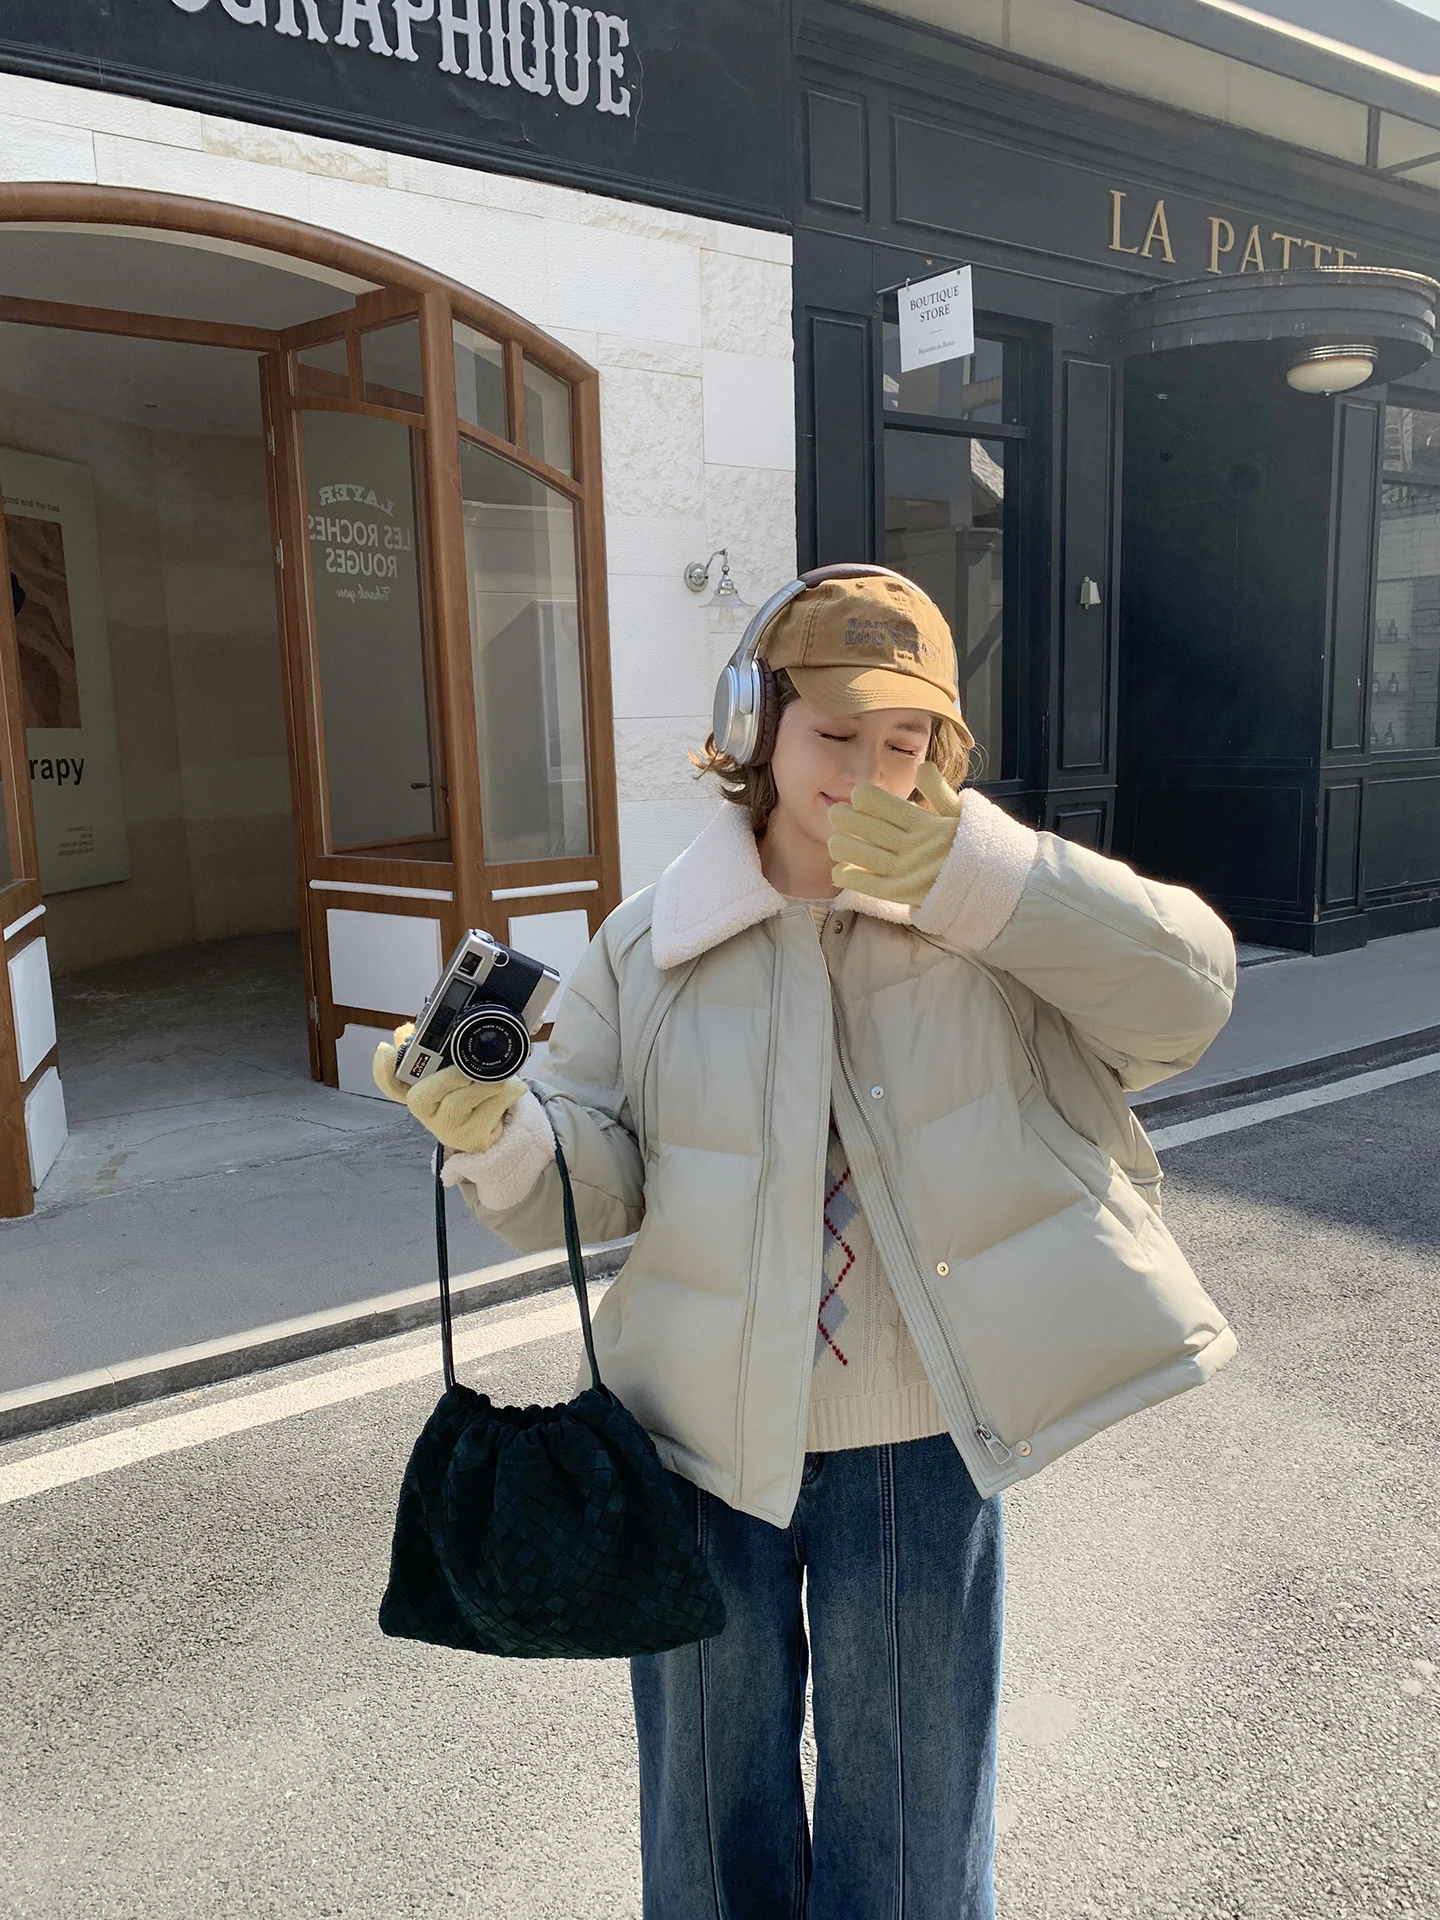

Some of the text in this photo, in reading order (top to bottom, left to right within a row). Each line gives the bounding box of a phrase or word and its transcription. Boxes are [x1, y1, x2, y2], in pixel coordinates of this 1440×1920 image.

[1108, 189, 1176, 263] LA
[910, 285, 960, 311] BOUTIQUE
[919, 303, 951, 323] STORE
[29, 758, 85, 786] rapy
